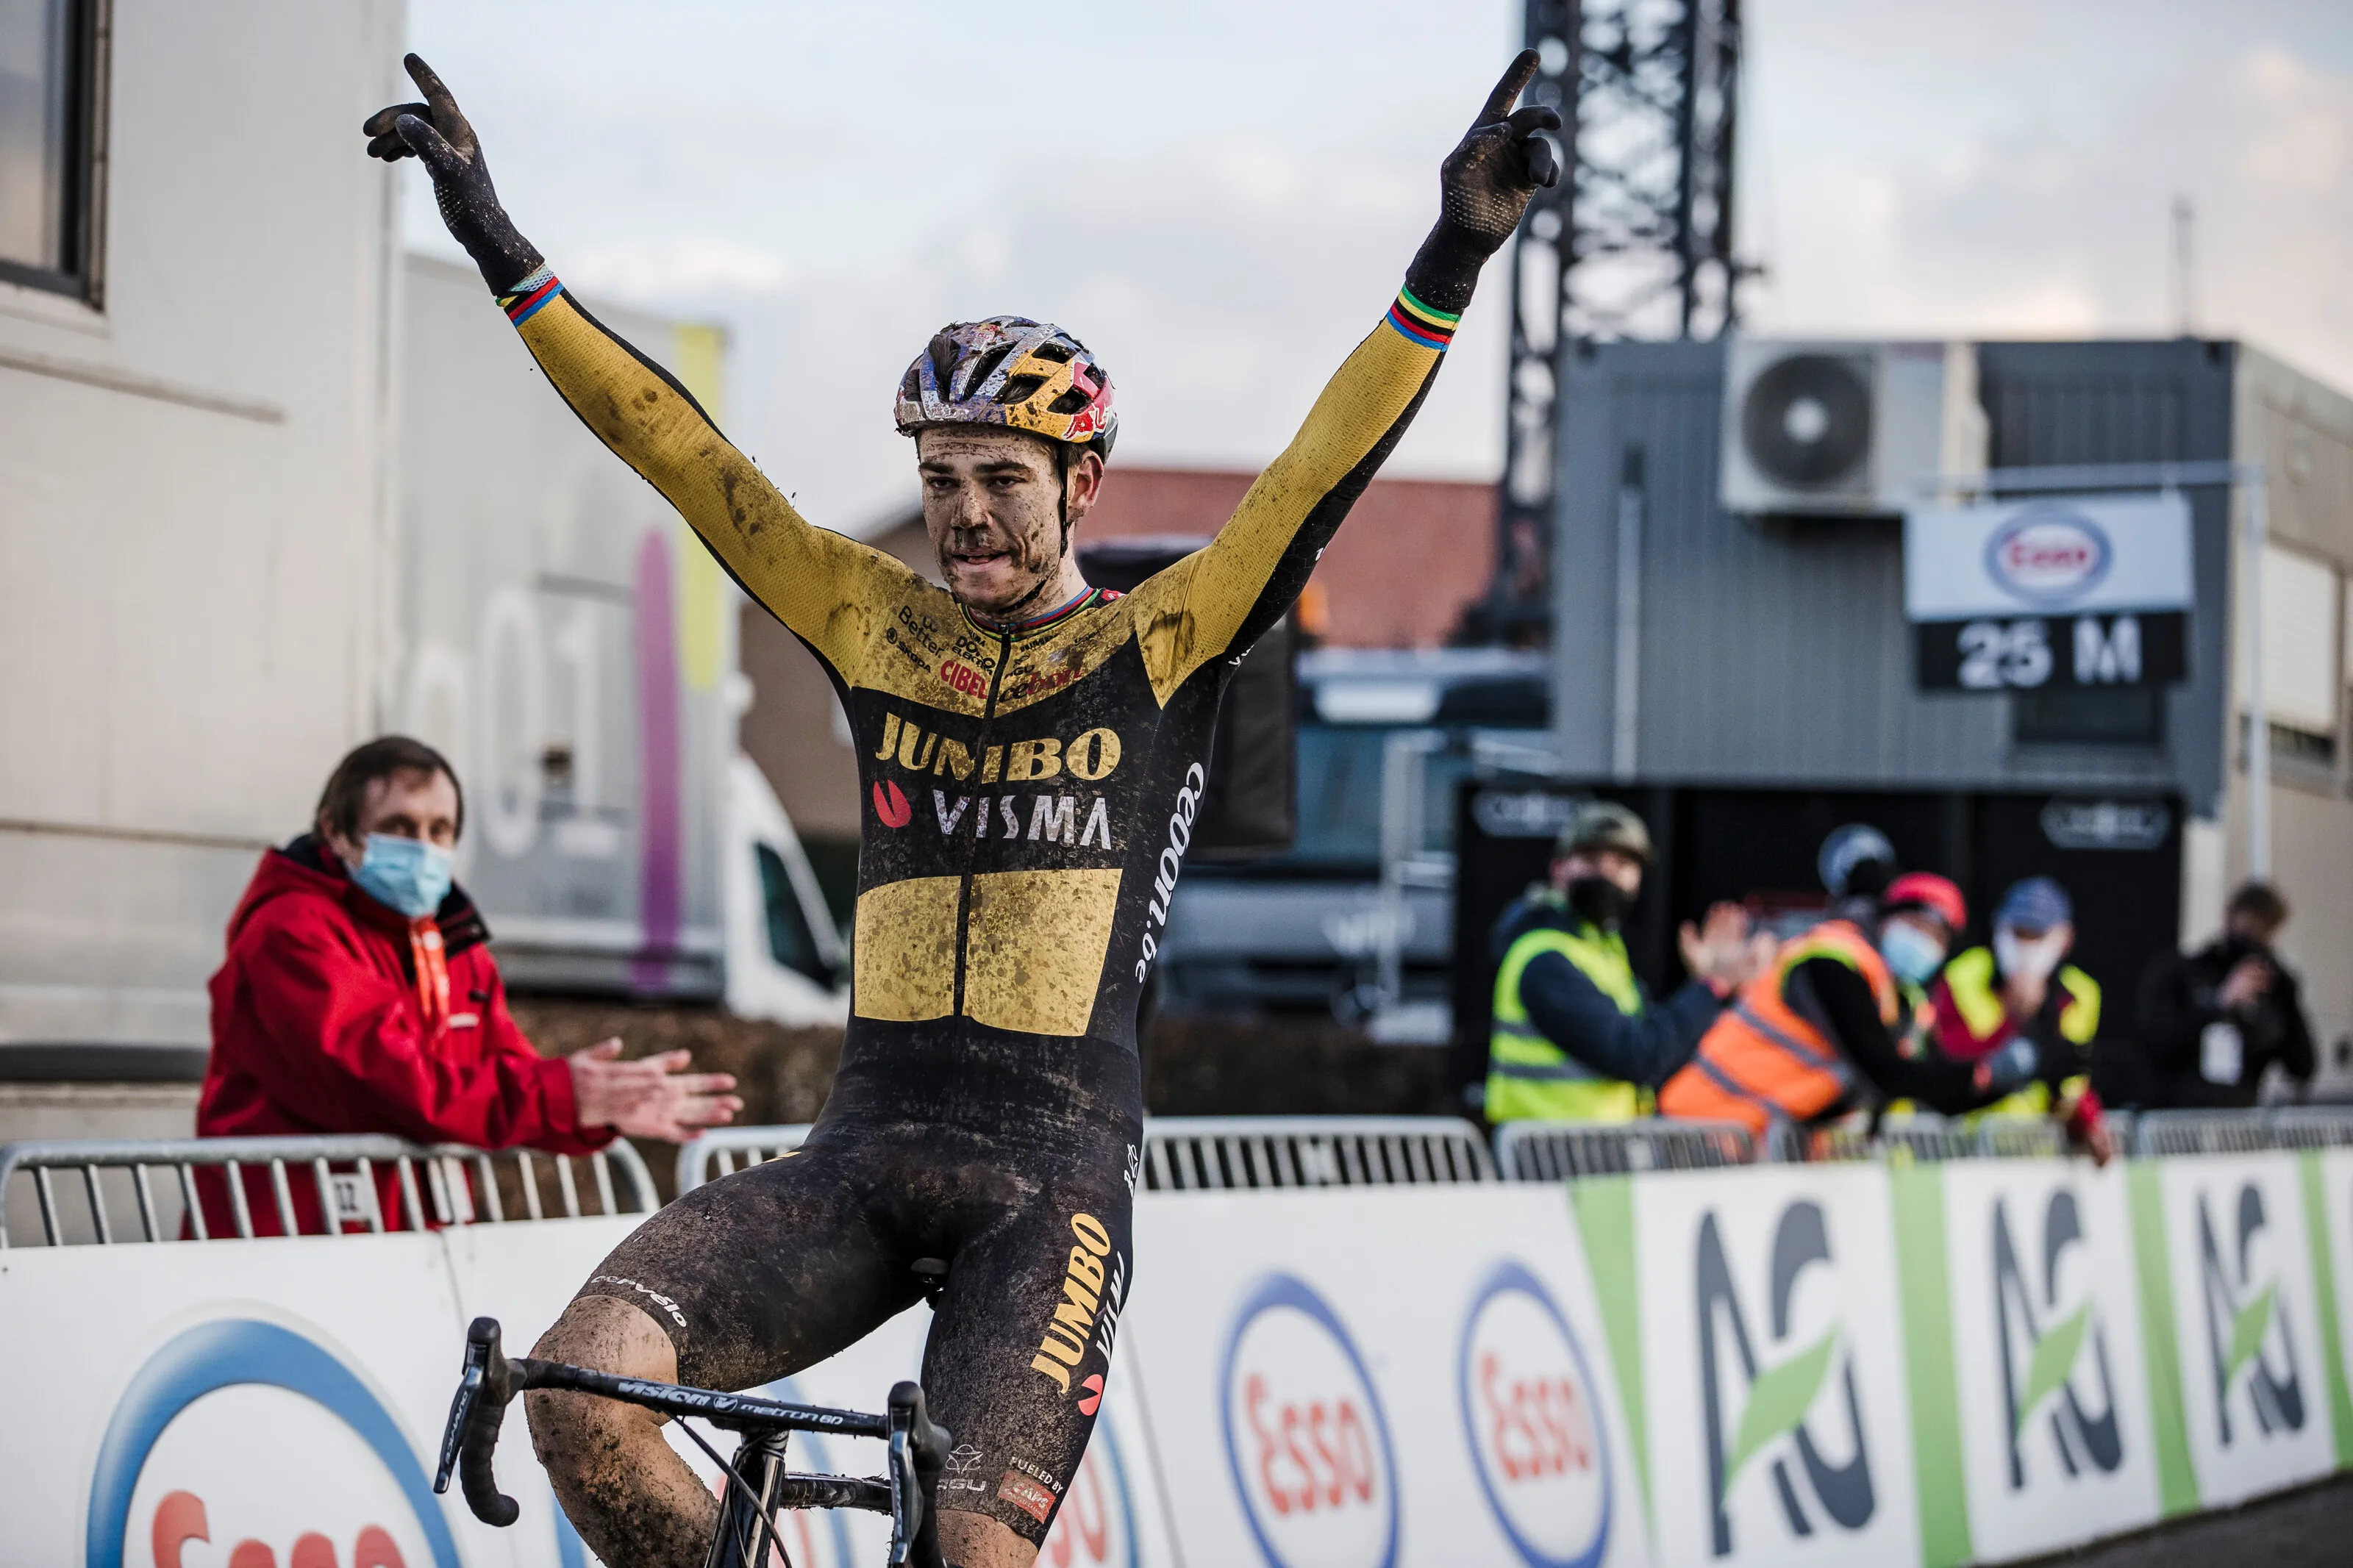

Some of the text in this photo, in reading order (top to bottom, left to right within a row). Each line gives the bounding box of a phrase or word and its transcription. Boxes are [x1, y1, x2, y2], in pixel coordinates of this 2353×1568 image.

[940, 659, 988, 700] CIBEL
[1957, 615, 2143, 690] 25 M
[876, 712, 1121, 784] JUMBO
[932, 789, 1112, 851] VISMA
[1030, 1213, 1111, 1395] JUMBO
[740, 1403, 819, 1420] metron
[1246, 1373, 1375, 1515] Esso
[1010, 1456, 1063, 1494] FUELED BY
